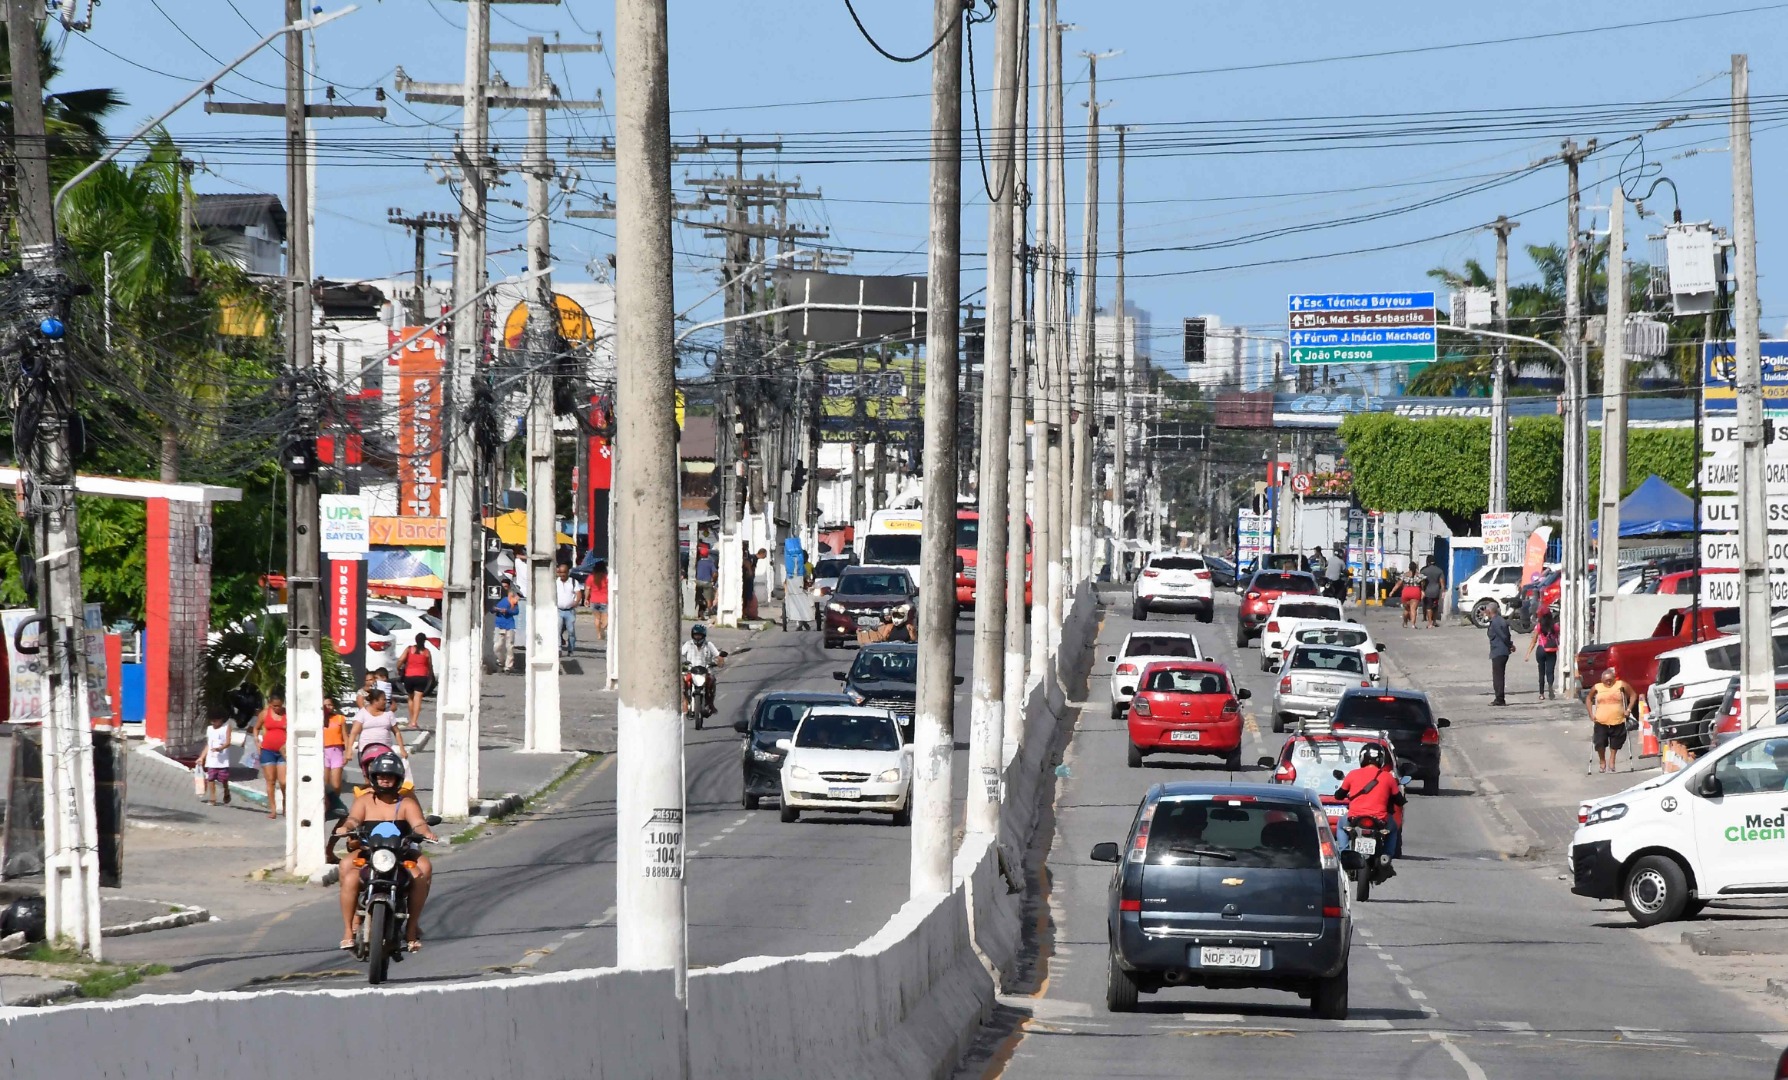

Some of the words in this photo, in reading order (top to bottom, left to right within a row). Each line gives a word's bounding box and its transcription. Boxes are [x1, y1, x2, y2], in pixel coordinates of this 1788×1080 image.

[1303, 299, 1324, 308] Esc.
[1327, 297, 1368, 308] Técnica
[1371, 297, 1412, 308] Bayeux
[1329, 315, 1350, 324] Mat.
[1353, 314, 1372, 324] São
[1304, 332, 1338, 343] Fórum
[1351, 331, 1382, 342] Inácio
[1385, 331, 1431, 341] Machado
[1304, 350, 1330, 360] João
[1333, 350, 1373, 359] Pessoa
[1394, 404, 1492, 418] NATURAL
[326, 506, 363, 520] UPA
[326, 532, 365, 541] BAYEUX
[338, 565, 348, 647] URGÊNCIA
[1662, 799, 1677, 809] 05
[1745, 813, 1785, 829] Med
[1724, 826, 1785, 842] Clean
